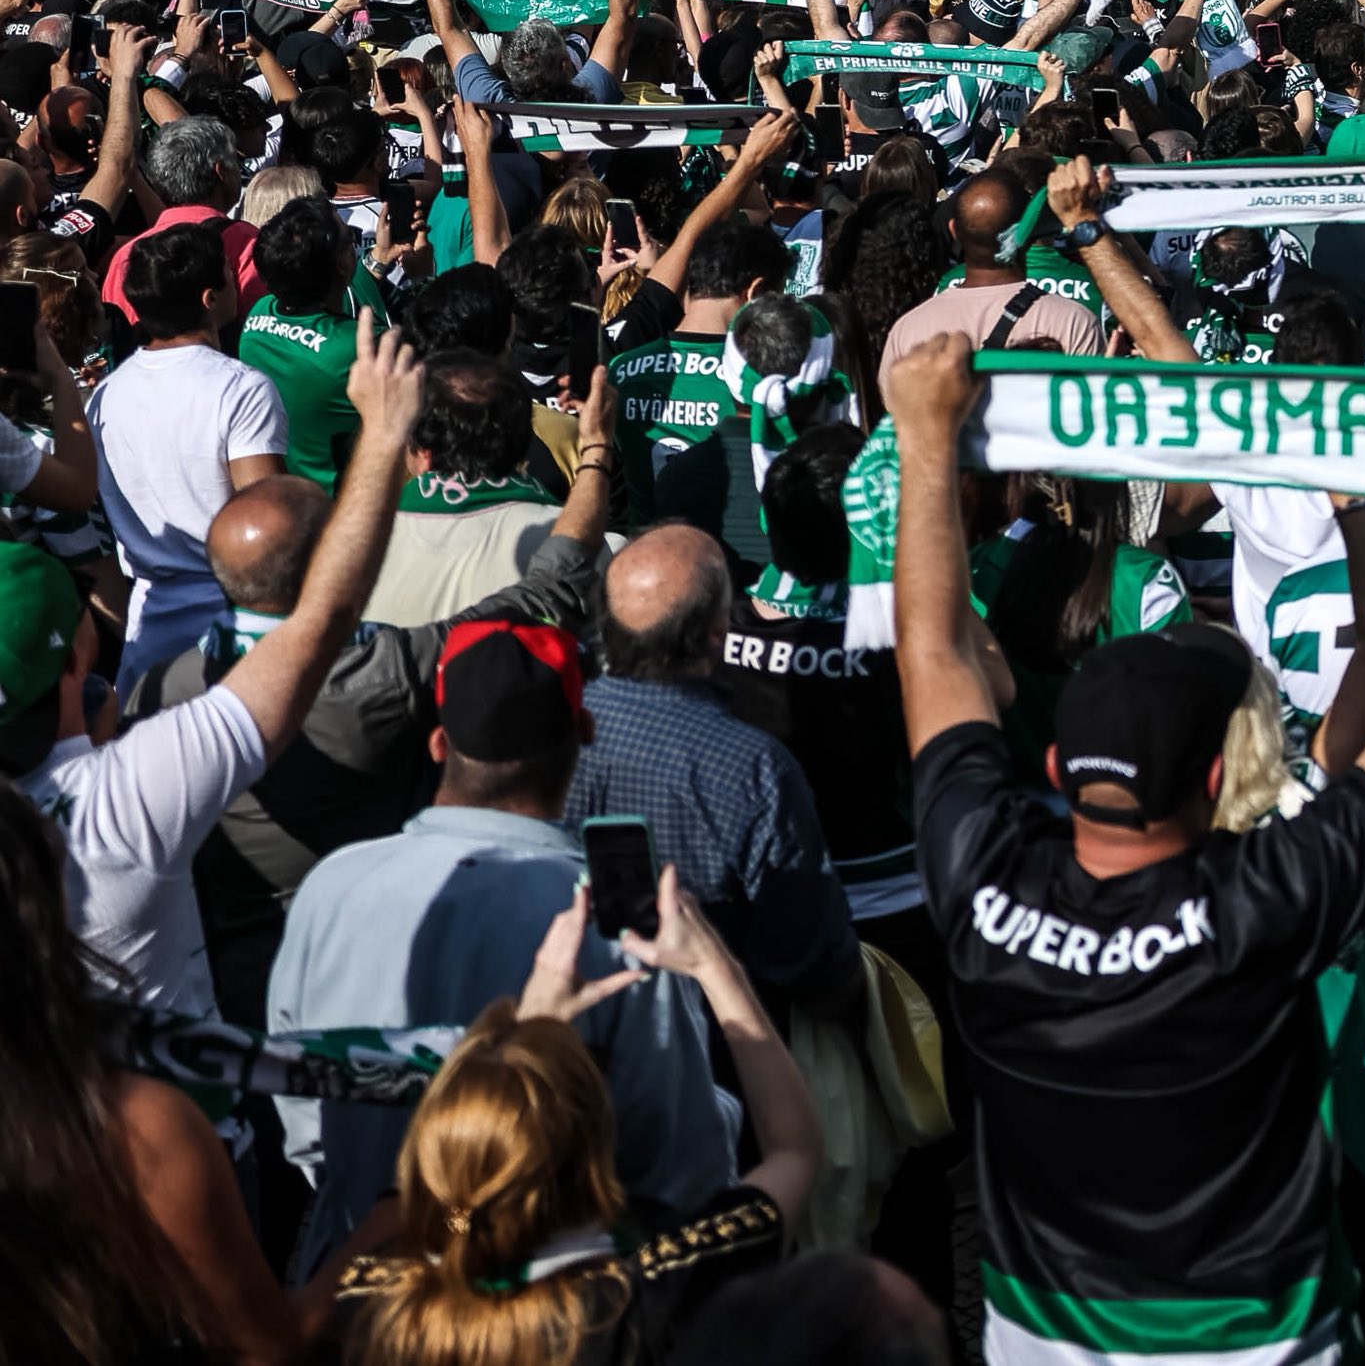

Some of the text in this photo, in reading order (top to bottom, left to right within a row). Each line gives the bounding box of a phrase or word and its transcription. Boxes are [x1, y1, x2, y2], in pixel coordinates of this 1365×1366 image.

[815, 57, 836, 71] EM
[842, 55, 912, 70] PRIMEIRO
[976, 62, 1003, 77] FIM
[616, 352, 681, 381] SUPER
[625, 394, 720, 427] GYÖKERES
[767, 641, 870, 678] BOCK
[972, 884, 1097, 976] SUPER
